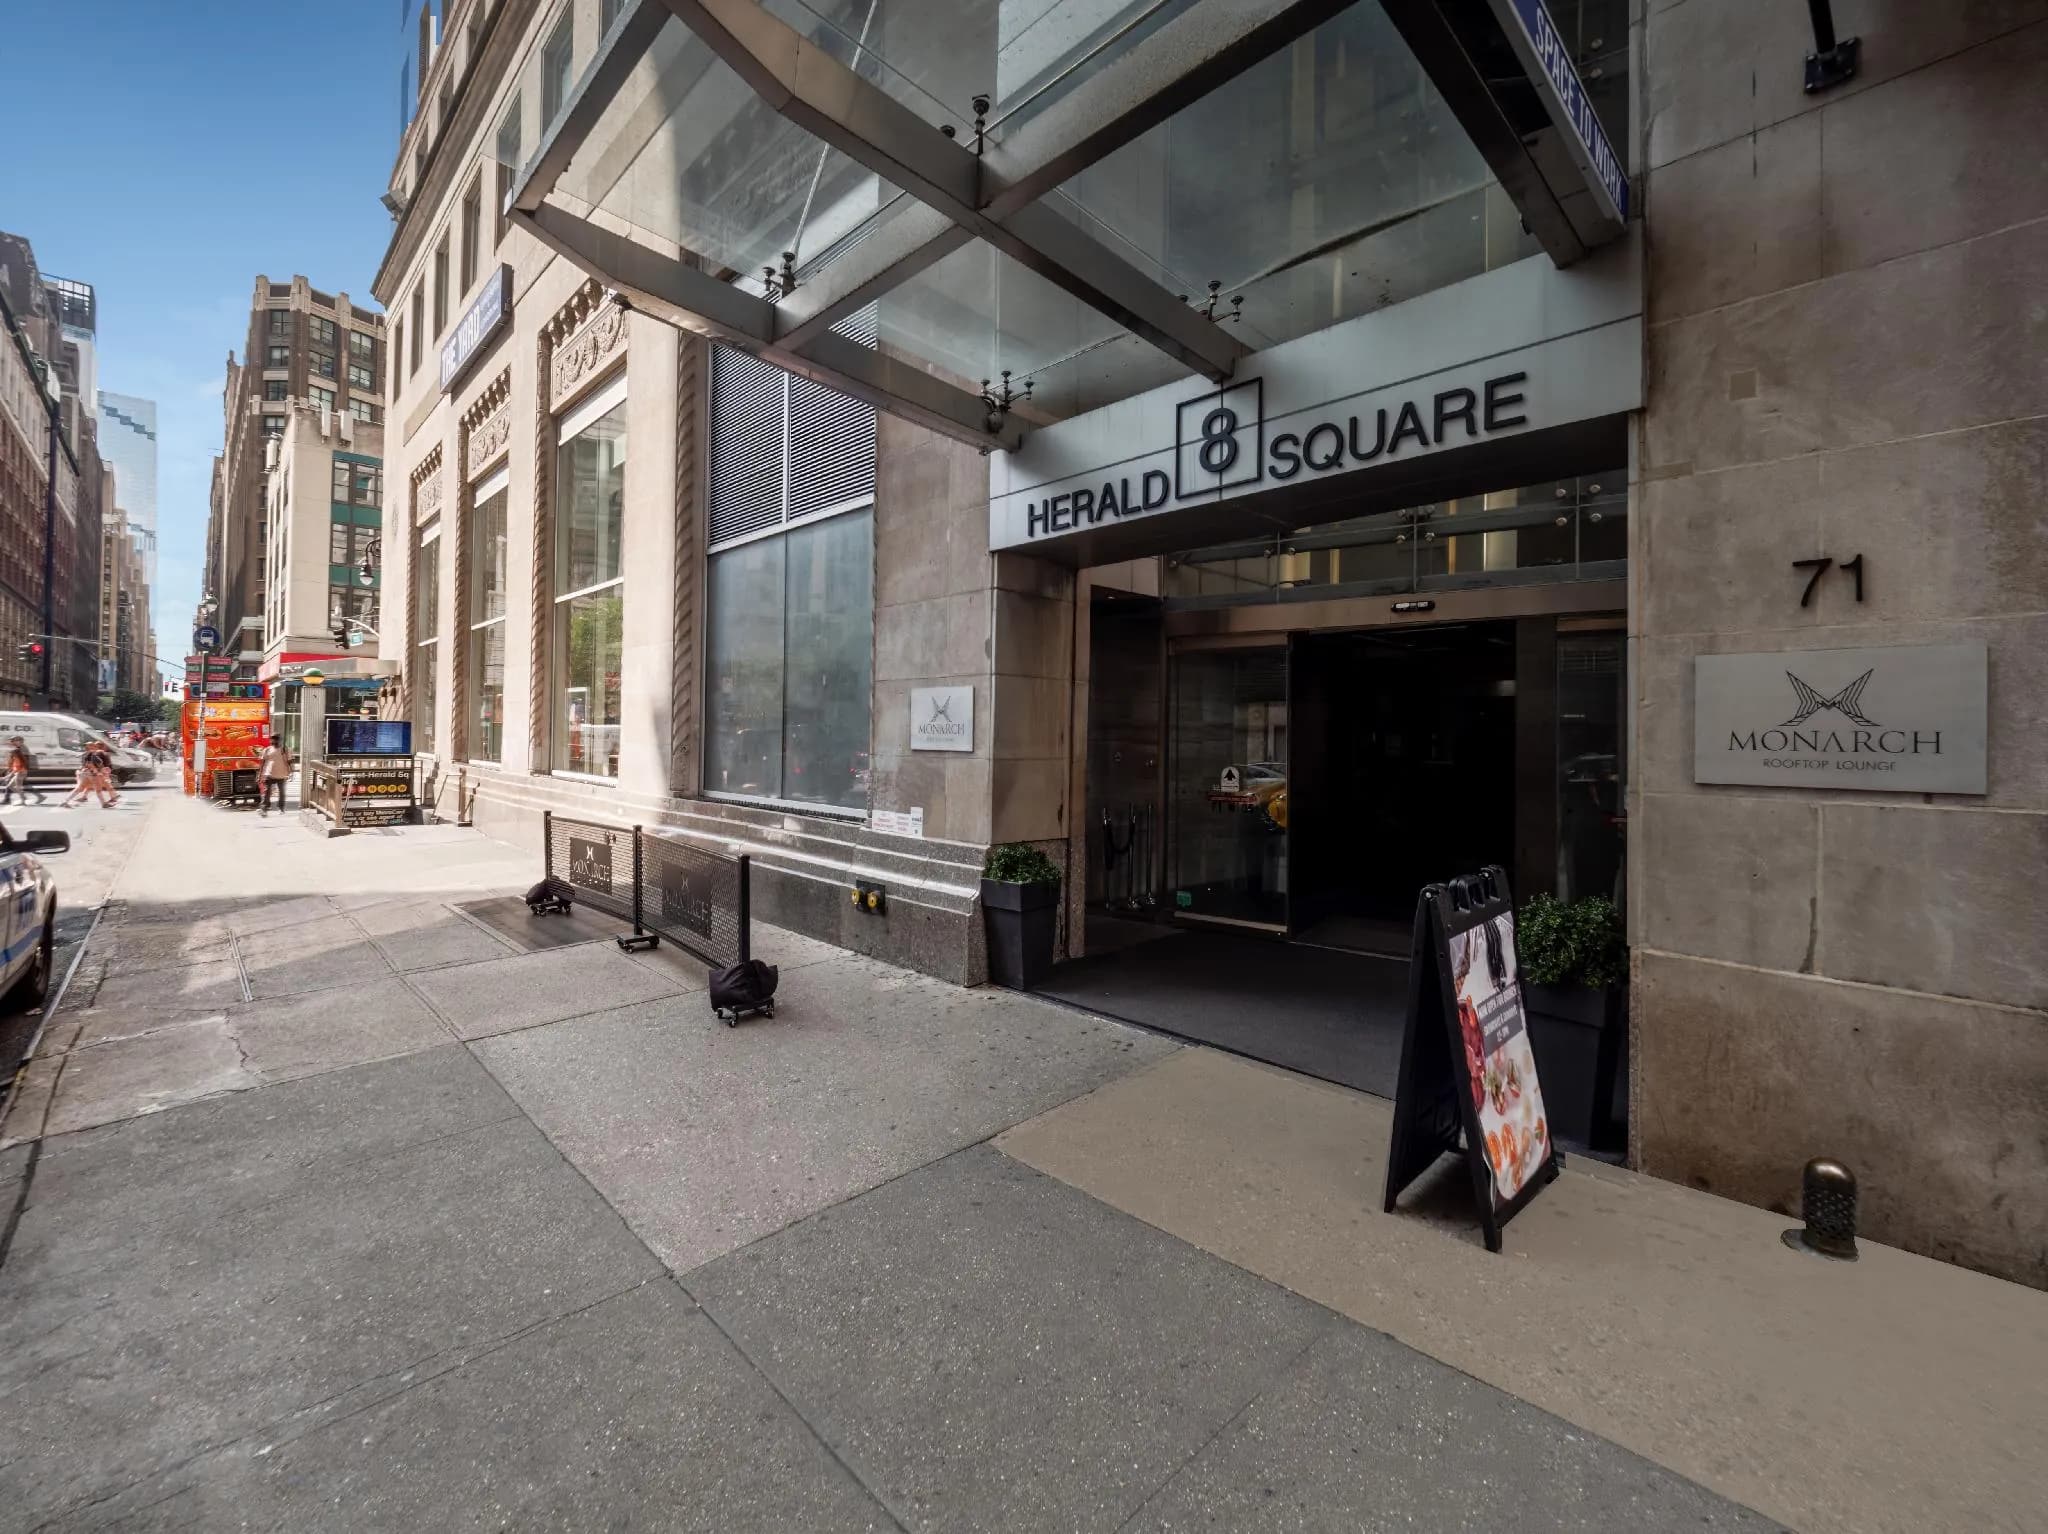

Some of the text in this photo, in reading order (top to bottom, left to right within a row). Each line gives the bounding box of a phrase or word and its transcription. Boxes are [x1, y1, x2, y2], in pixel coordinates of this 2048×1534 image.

[1536, 8, 1622, 209] SPACE TO WORK
[442, 305, 480, 382] THE YARD
[1028, 371, 1527, 537] HERALD 8 SQUARE
[1792, 553, 1864, 608] 71
[918, 722, 965, 736] MONARCH
[1728, 729, 1944, 754] MONARCH
[1763, 758, 1896, 772] ROOFTOP LOUNGE
